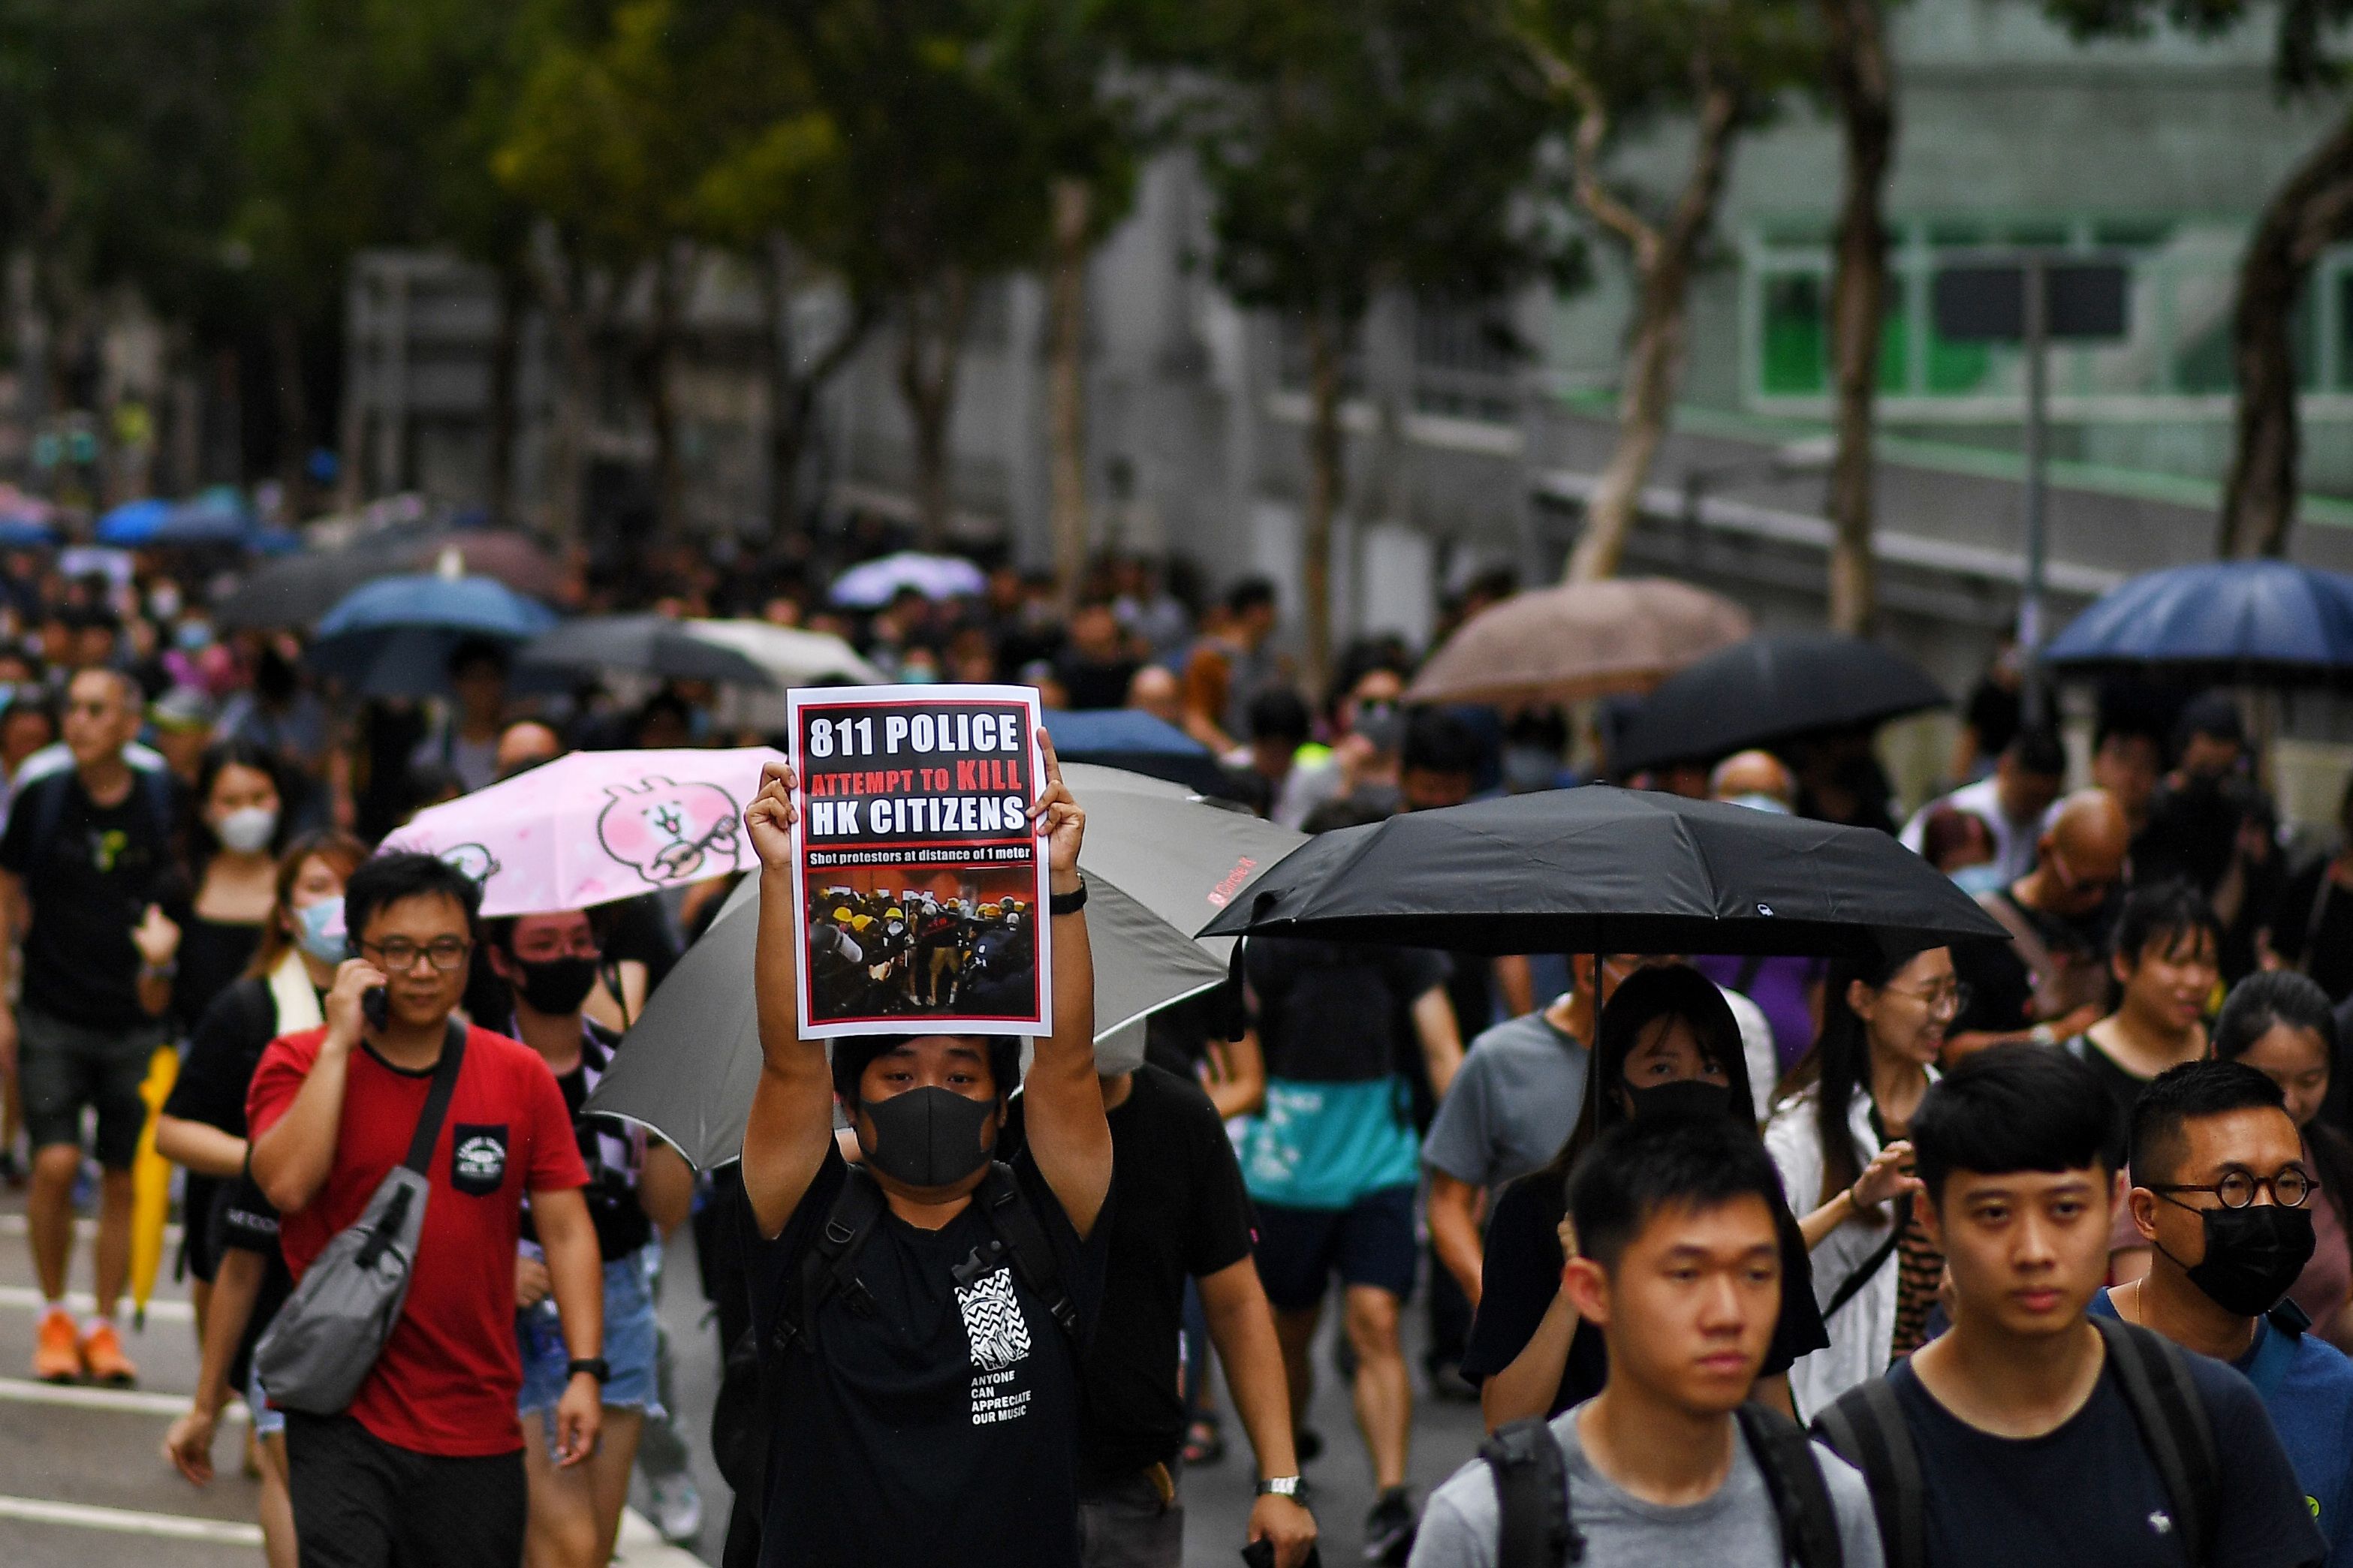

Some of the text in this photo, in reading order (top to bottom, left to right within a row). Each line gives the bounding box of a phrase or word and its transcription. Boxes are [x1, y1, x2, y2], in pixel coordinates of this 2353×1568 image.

[810, 714, 1020, 757] 811 POLICE
[811, 760, 1023, 797] ATTEMPT TO KILL
[812, 796, 1026, 835] HK CITIZENS
[810, 847, 1030, 865] Shot protestors at distance of 1 meter
[971, 1371, 1015, 1387] ANYONE
[971, 1386, 995, 1399] CAN
[972, 1390, 1032, 1413] APPRECIATE
[972, 1404, 1027, 1425] OUR MUSIC
